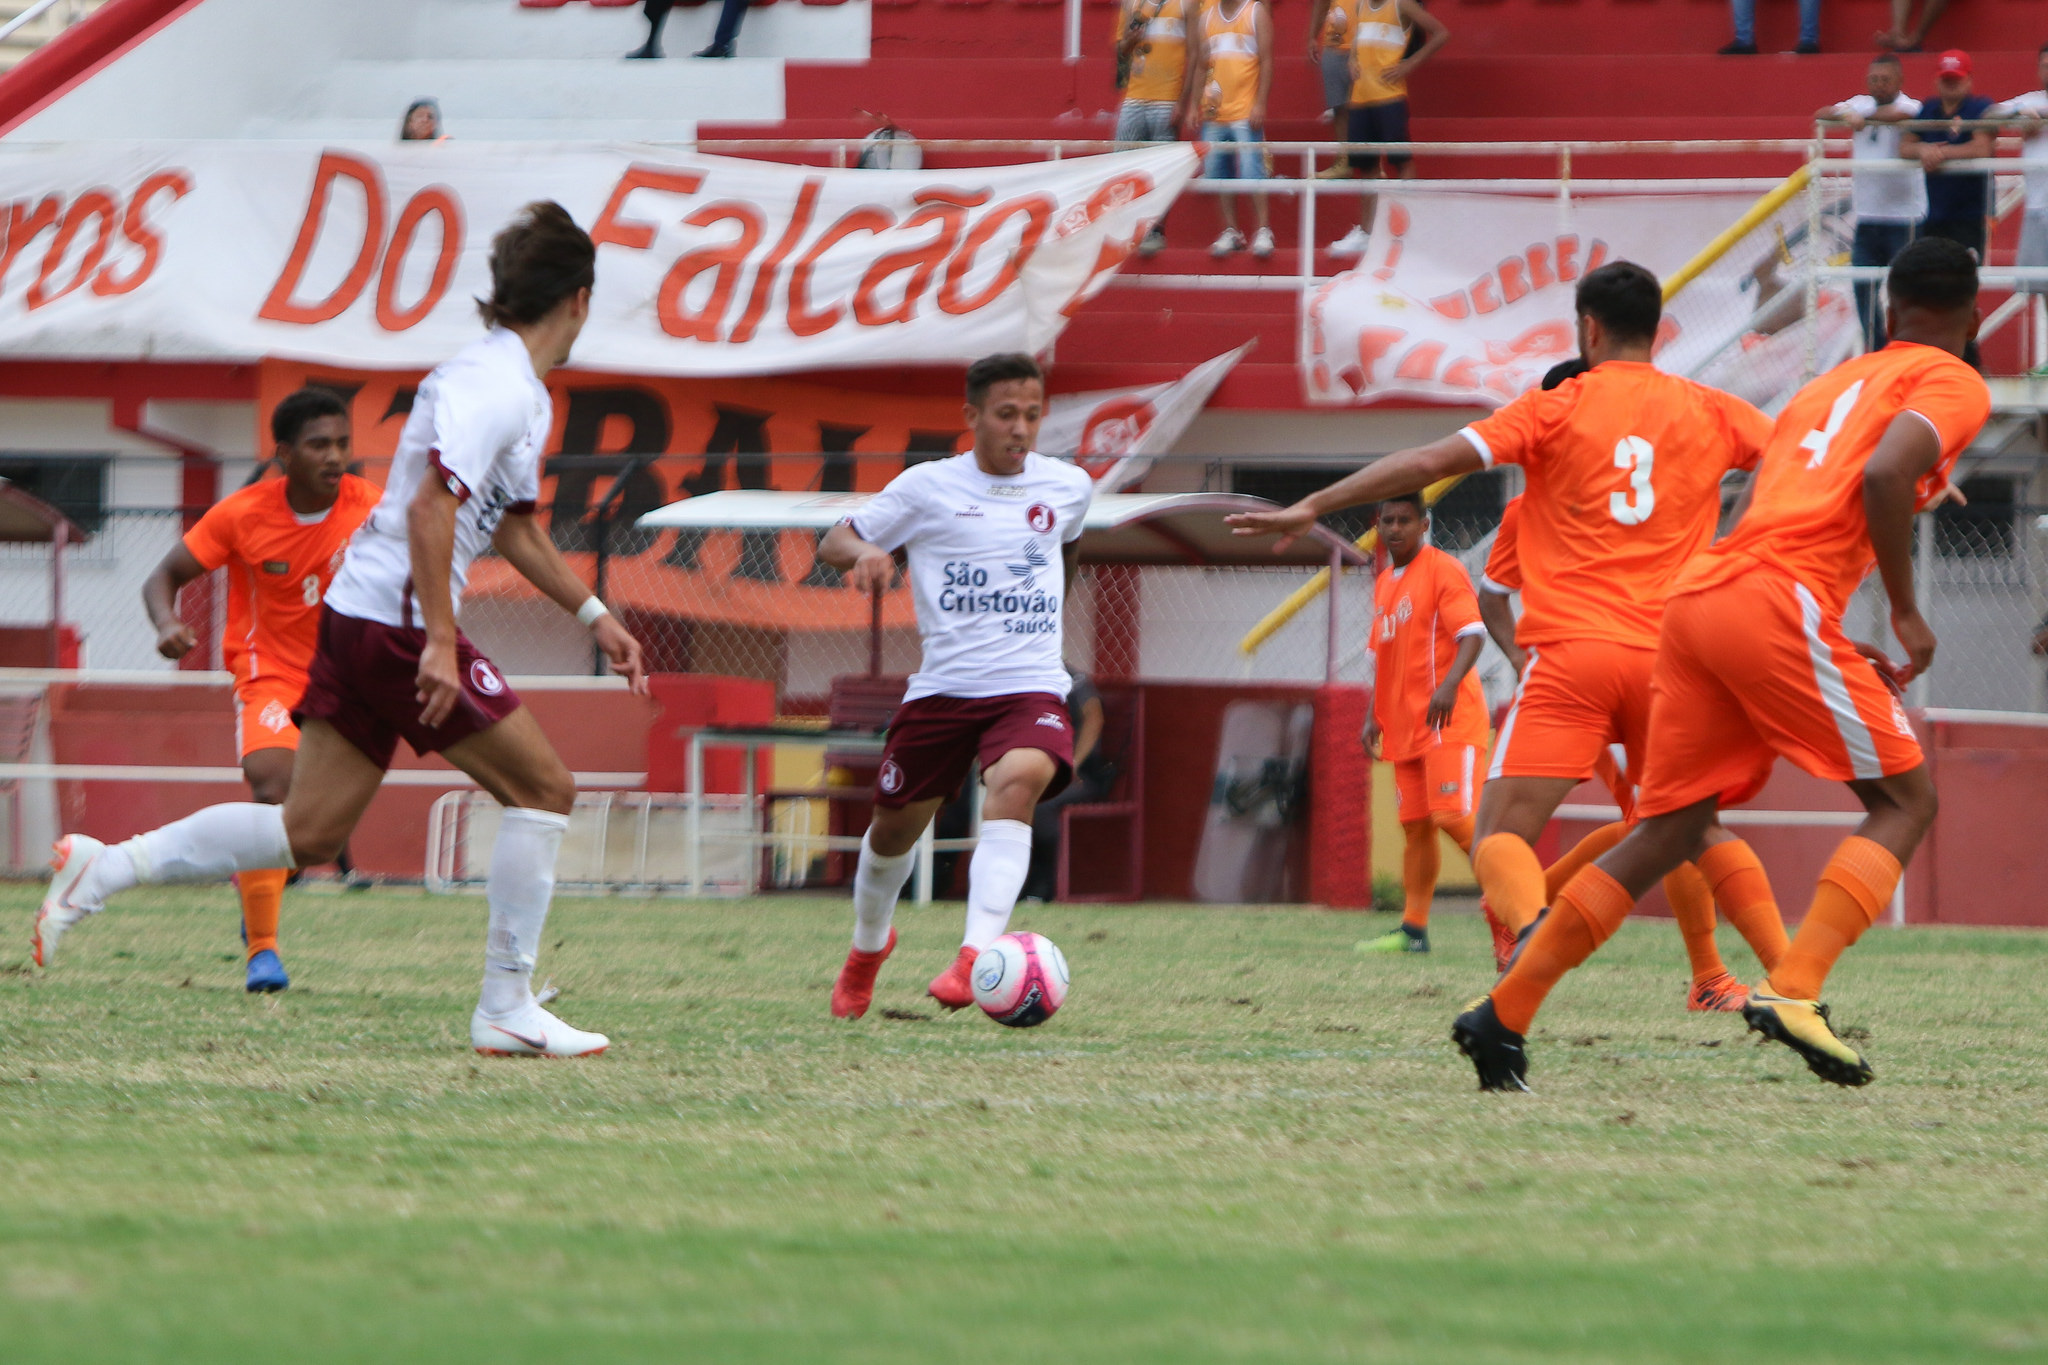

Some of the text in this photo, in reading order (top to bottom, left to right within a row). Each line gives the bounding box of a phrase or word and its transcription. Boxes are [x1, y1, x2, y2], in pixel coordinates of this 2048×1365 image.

[0, 148, 1058, 343] ros Do Falcão
[1609, 435, 1655, 526] 3
[943, 561, 988, 587] São
[302, 573, 320, 607] 8
[939, 587, 1057, 613] Cristóvão
[1003, 614, 1056, 634] saúde
